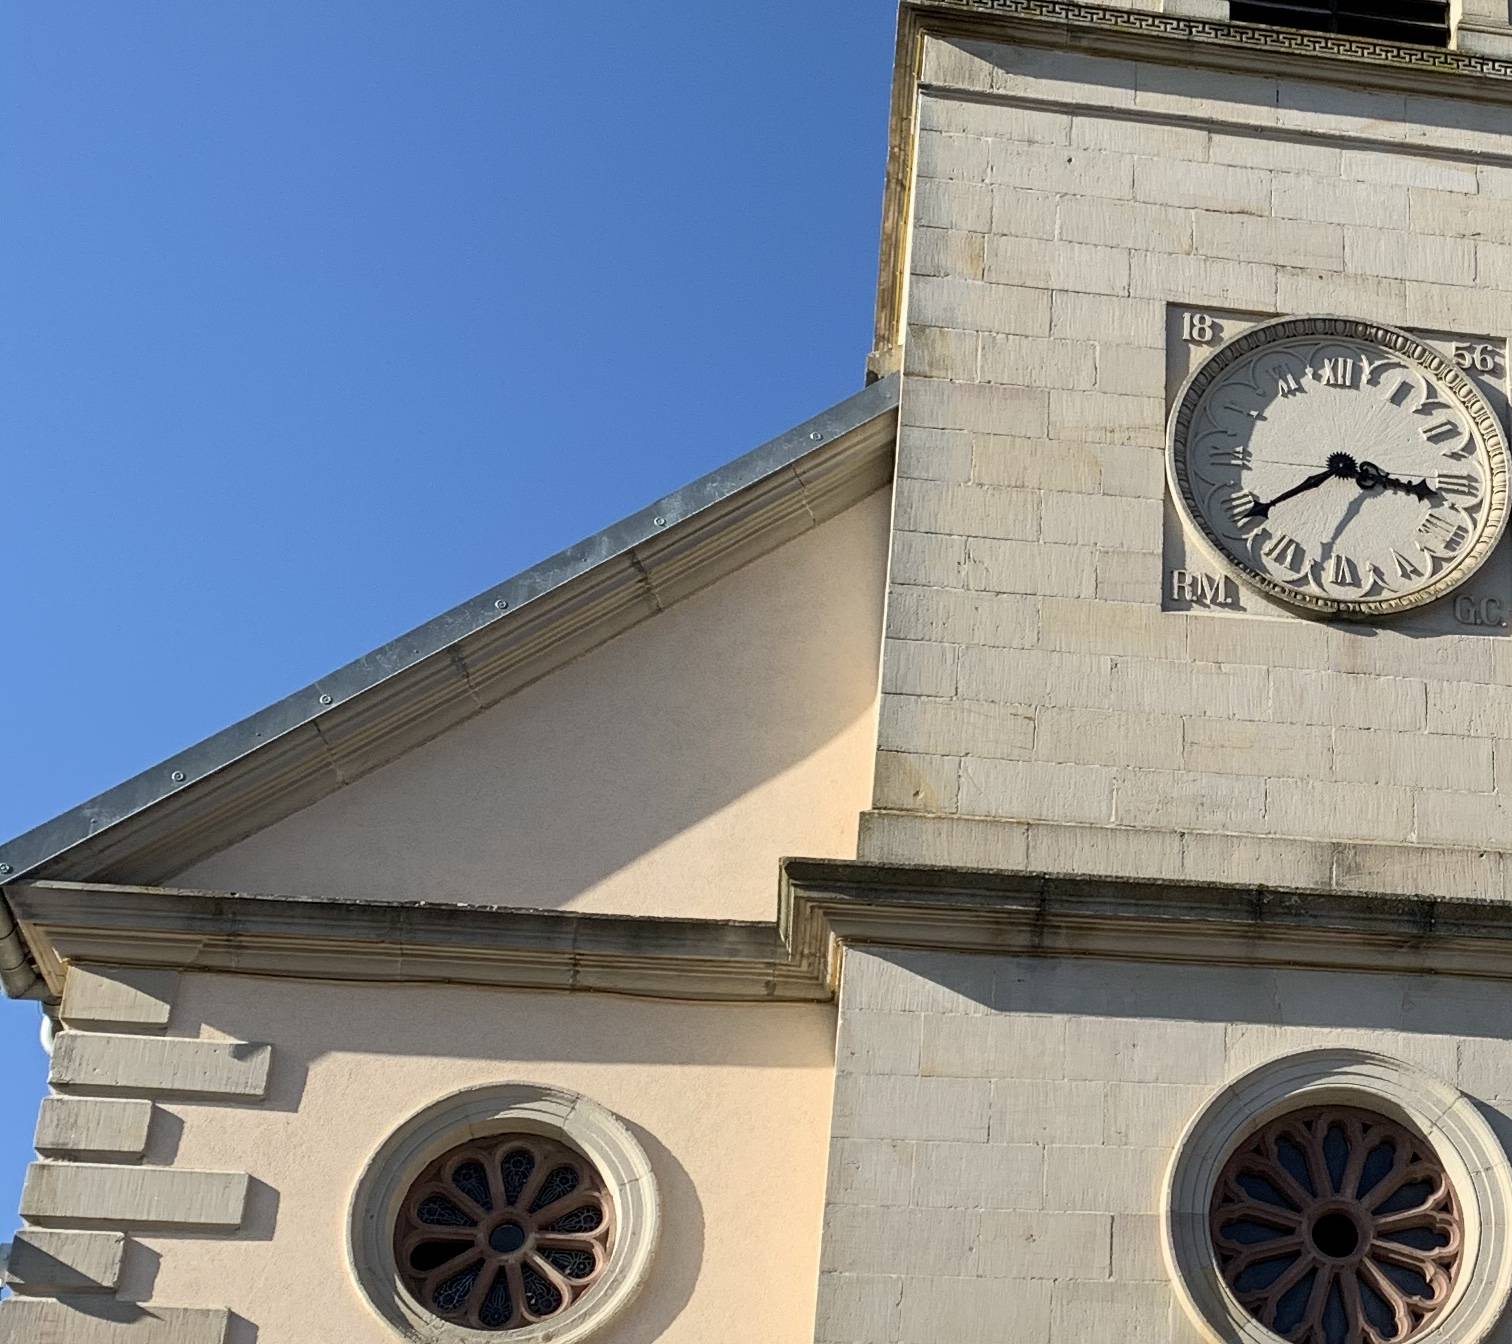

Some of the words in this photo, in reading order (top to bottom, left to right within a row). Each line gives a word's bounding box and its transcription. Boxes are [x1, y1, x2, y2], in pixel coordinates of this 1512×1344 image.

[1182, 312, 1213, 342] 18
[1452, 341, 1495, 371] 56
[1321, 357, 1354, 386] XII
[1434, 469, 1472, 494] III
[1329, 553, 1354, 584] VI
